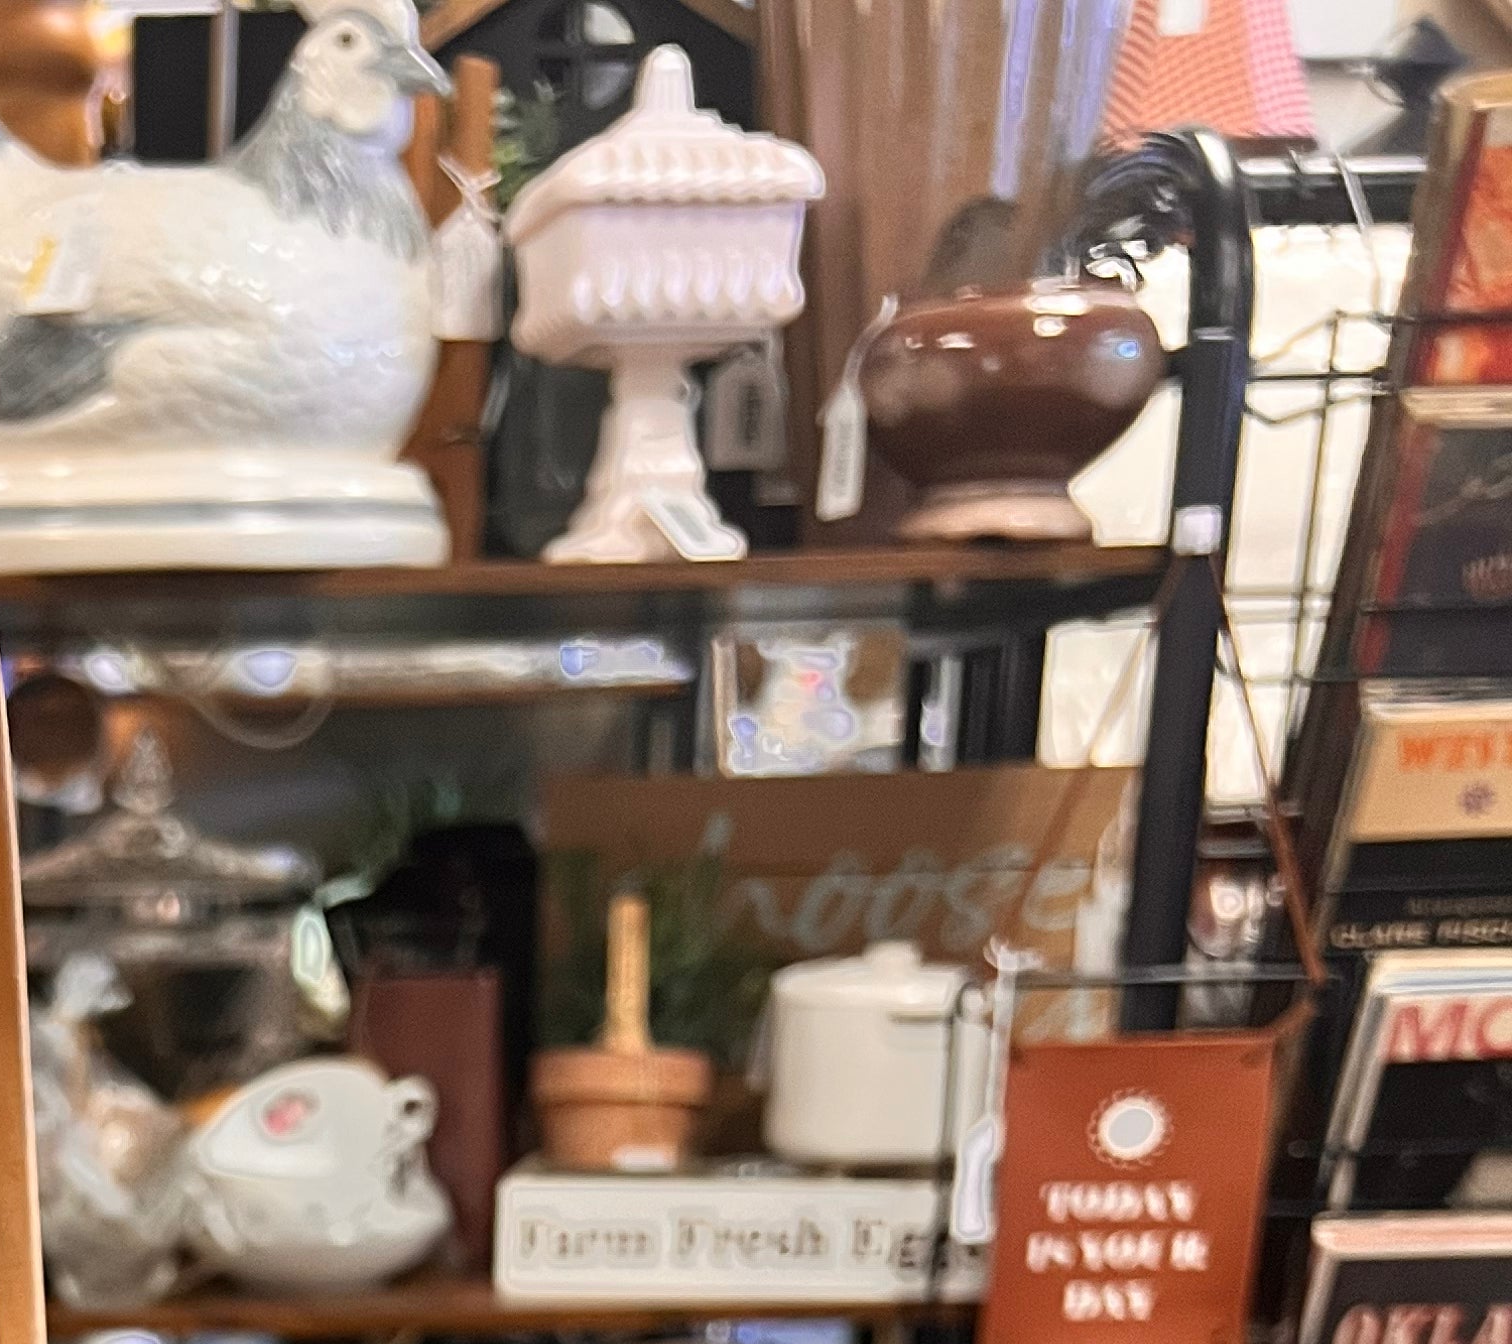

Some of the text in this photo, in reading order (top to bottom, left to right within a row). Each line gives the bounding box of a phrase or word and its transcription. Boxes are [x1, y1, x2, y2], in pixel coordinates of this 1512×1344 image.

[1040, 1179, 1198, 1223] TODAY
[519, 1216, 651, 1257] Farm
[677, 1214, 826, 1258] Fresh
[1078, 1228, 1212, 1272] YOUR
[1062, 1278, 1155, 1322] DAY
